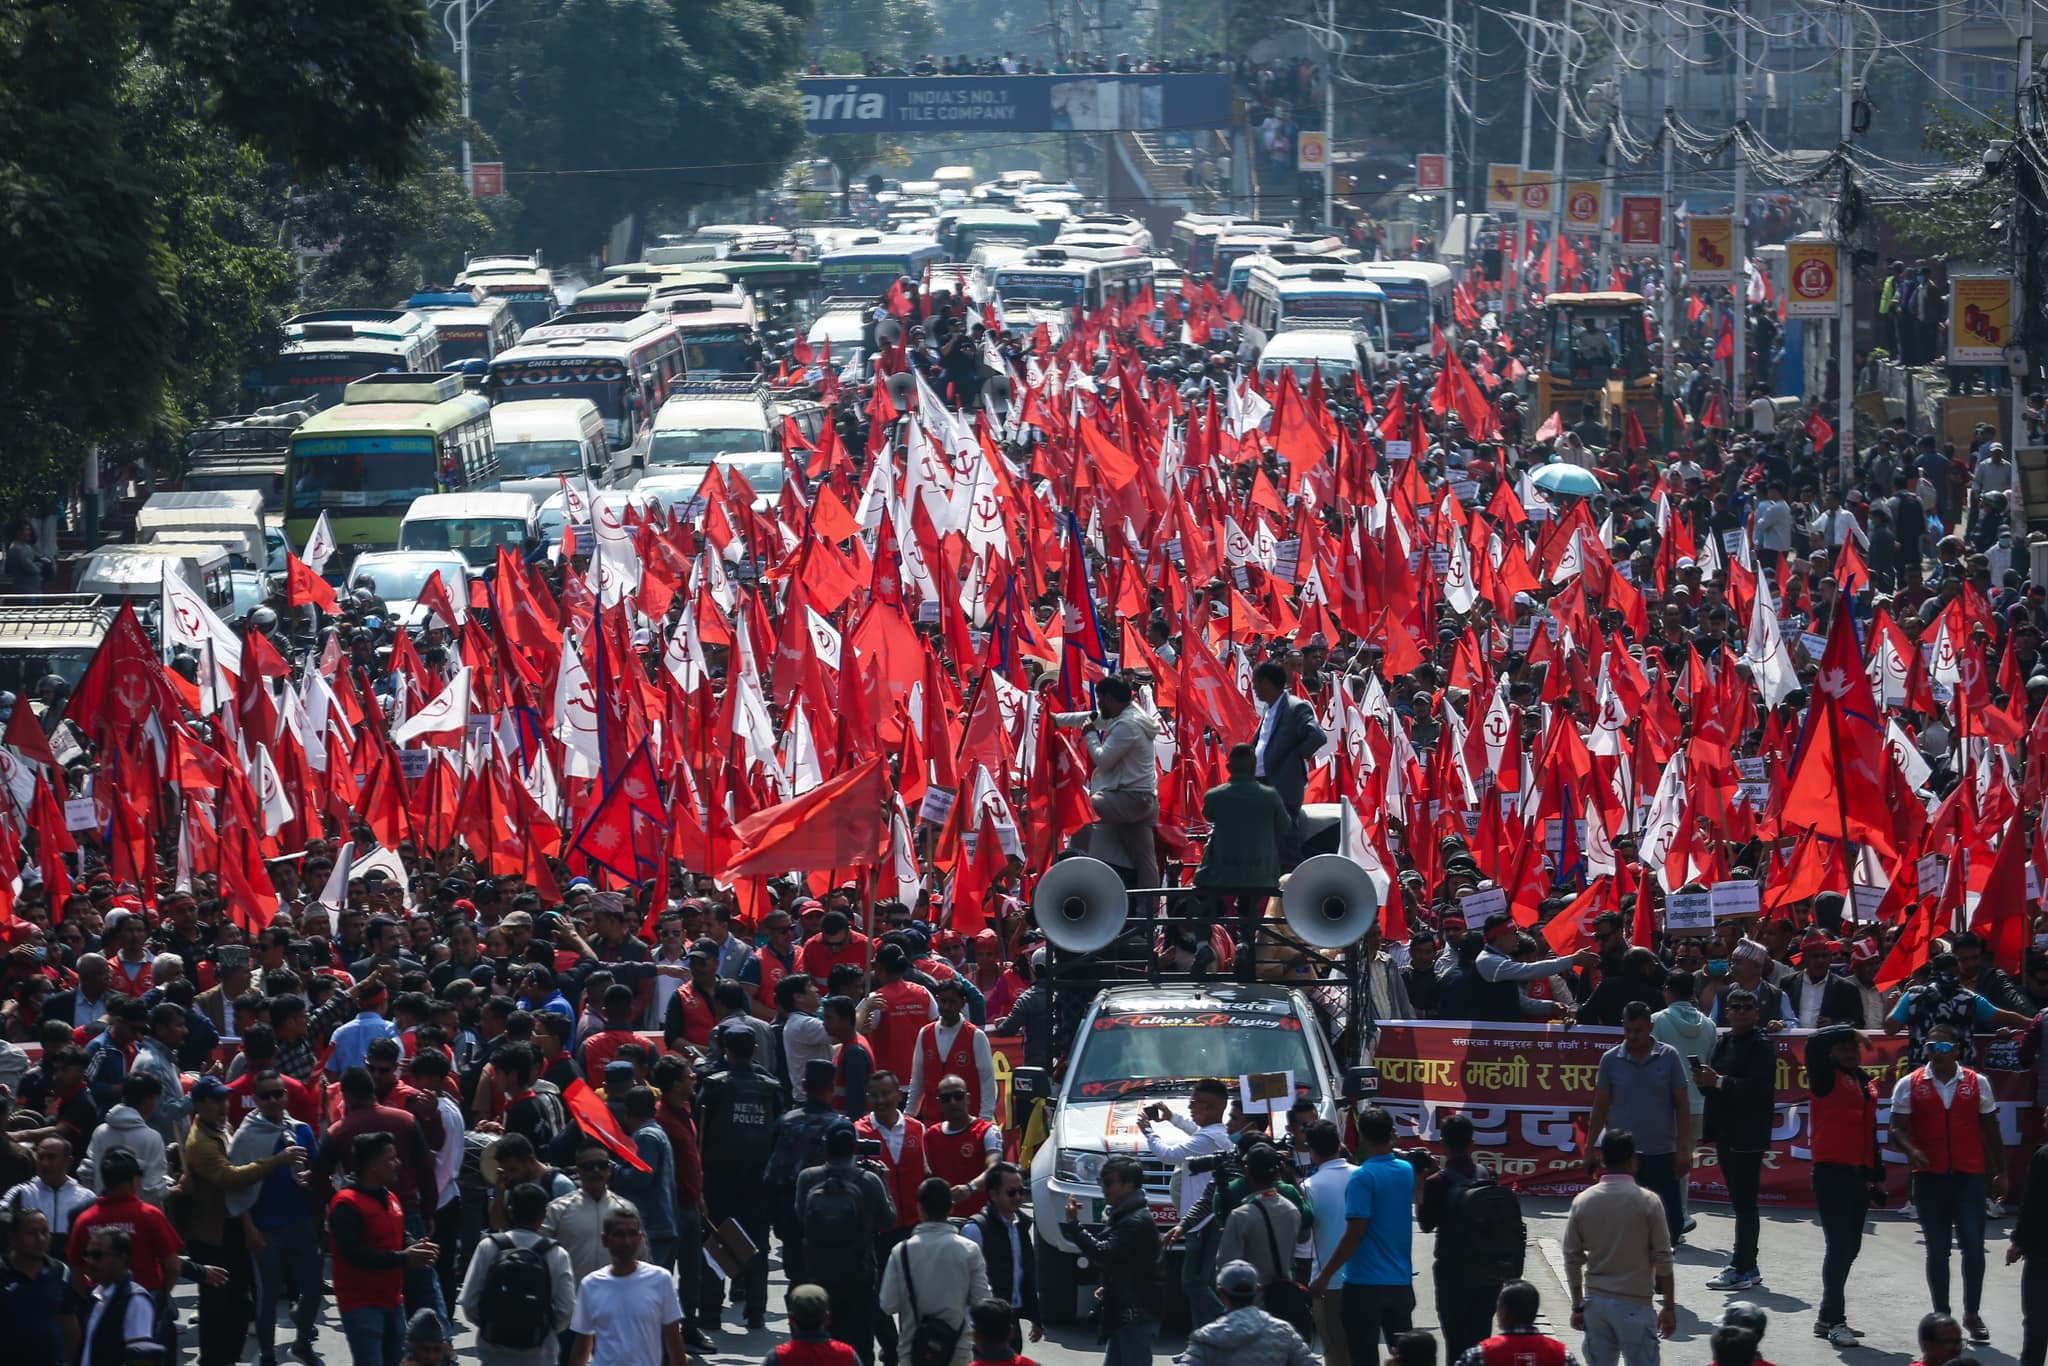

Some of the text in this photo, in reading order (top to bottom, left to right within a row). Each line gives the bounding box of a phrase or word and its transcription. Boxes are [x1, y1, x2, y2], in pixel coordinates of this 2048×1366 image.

[908, 90, 968, 104] INDIA'S
[898, 106, 1016, 120] TILE COMPANY
[537, 326, 609, 337] VOLVO
[497, 366, 622, 386] VOLVO
[1536, 1064, 1553, 1090] र
[1560, 1064, 1601, 1091] सर
[733, 1113, 765, 1125] POLICE
